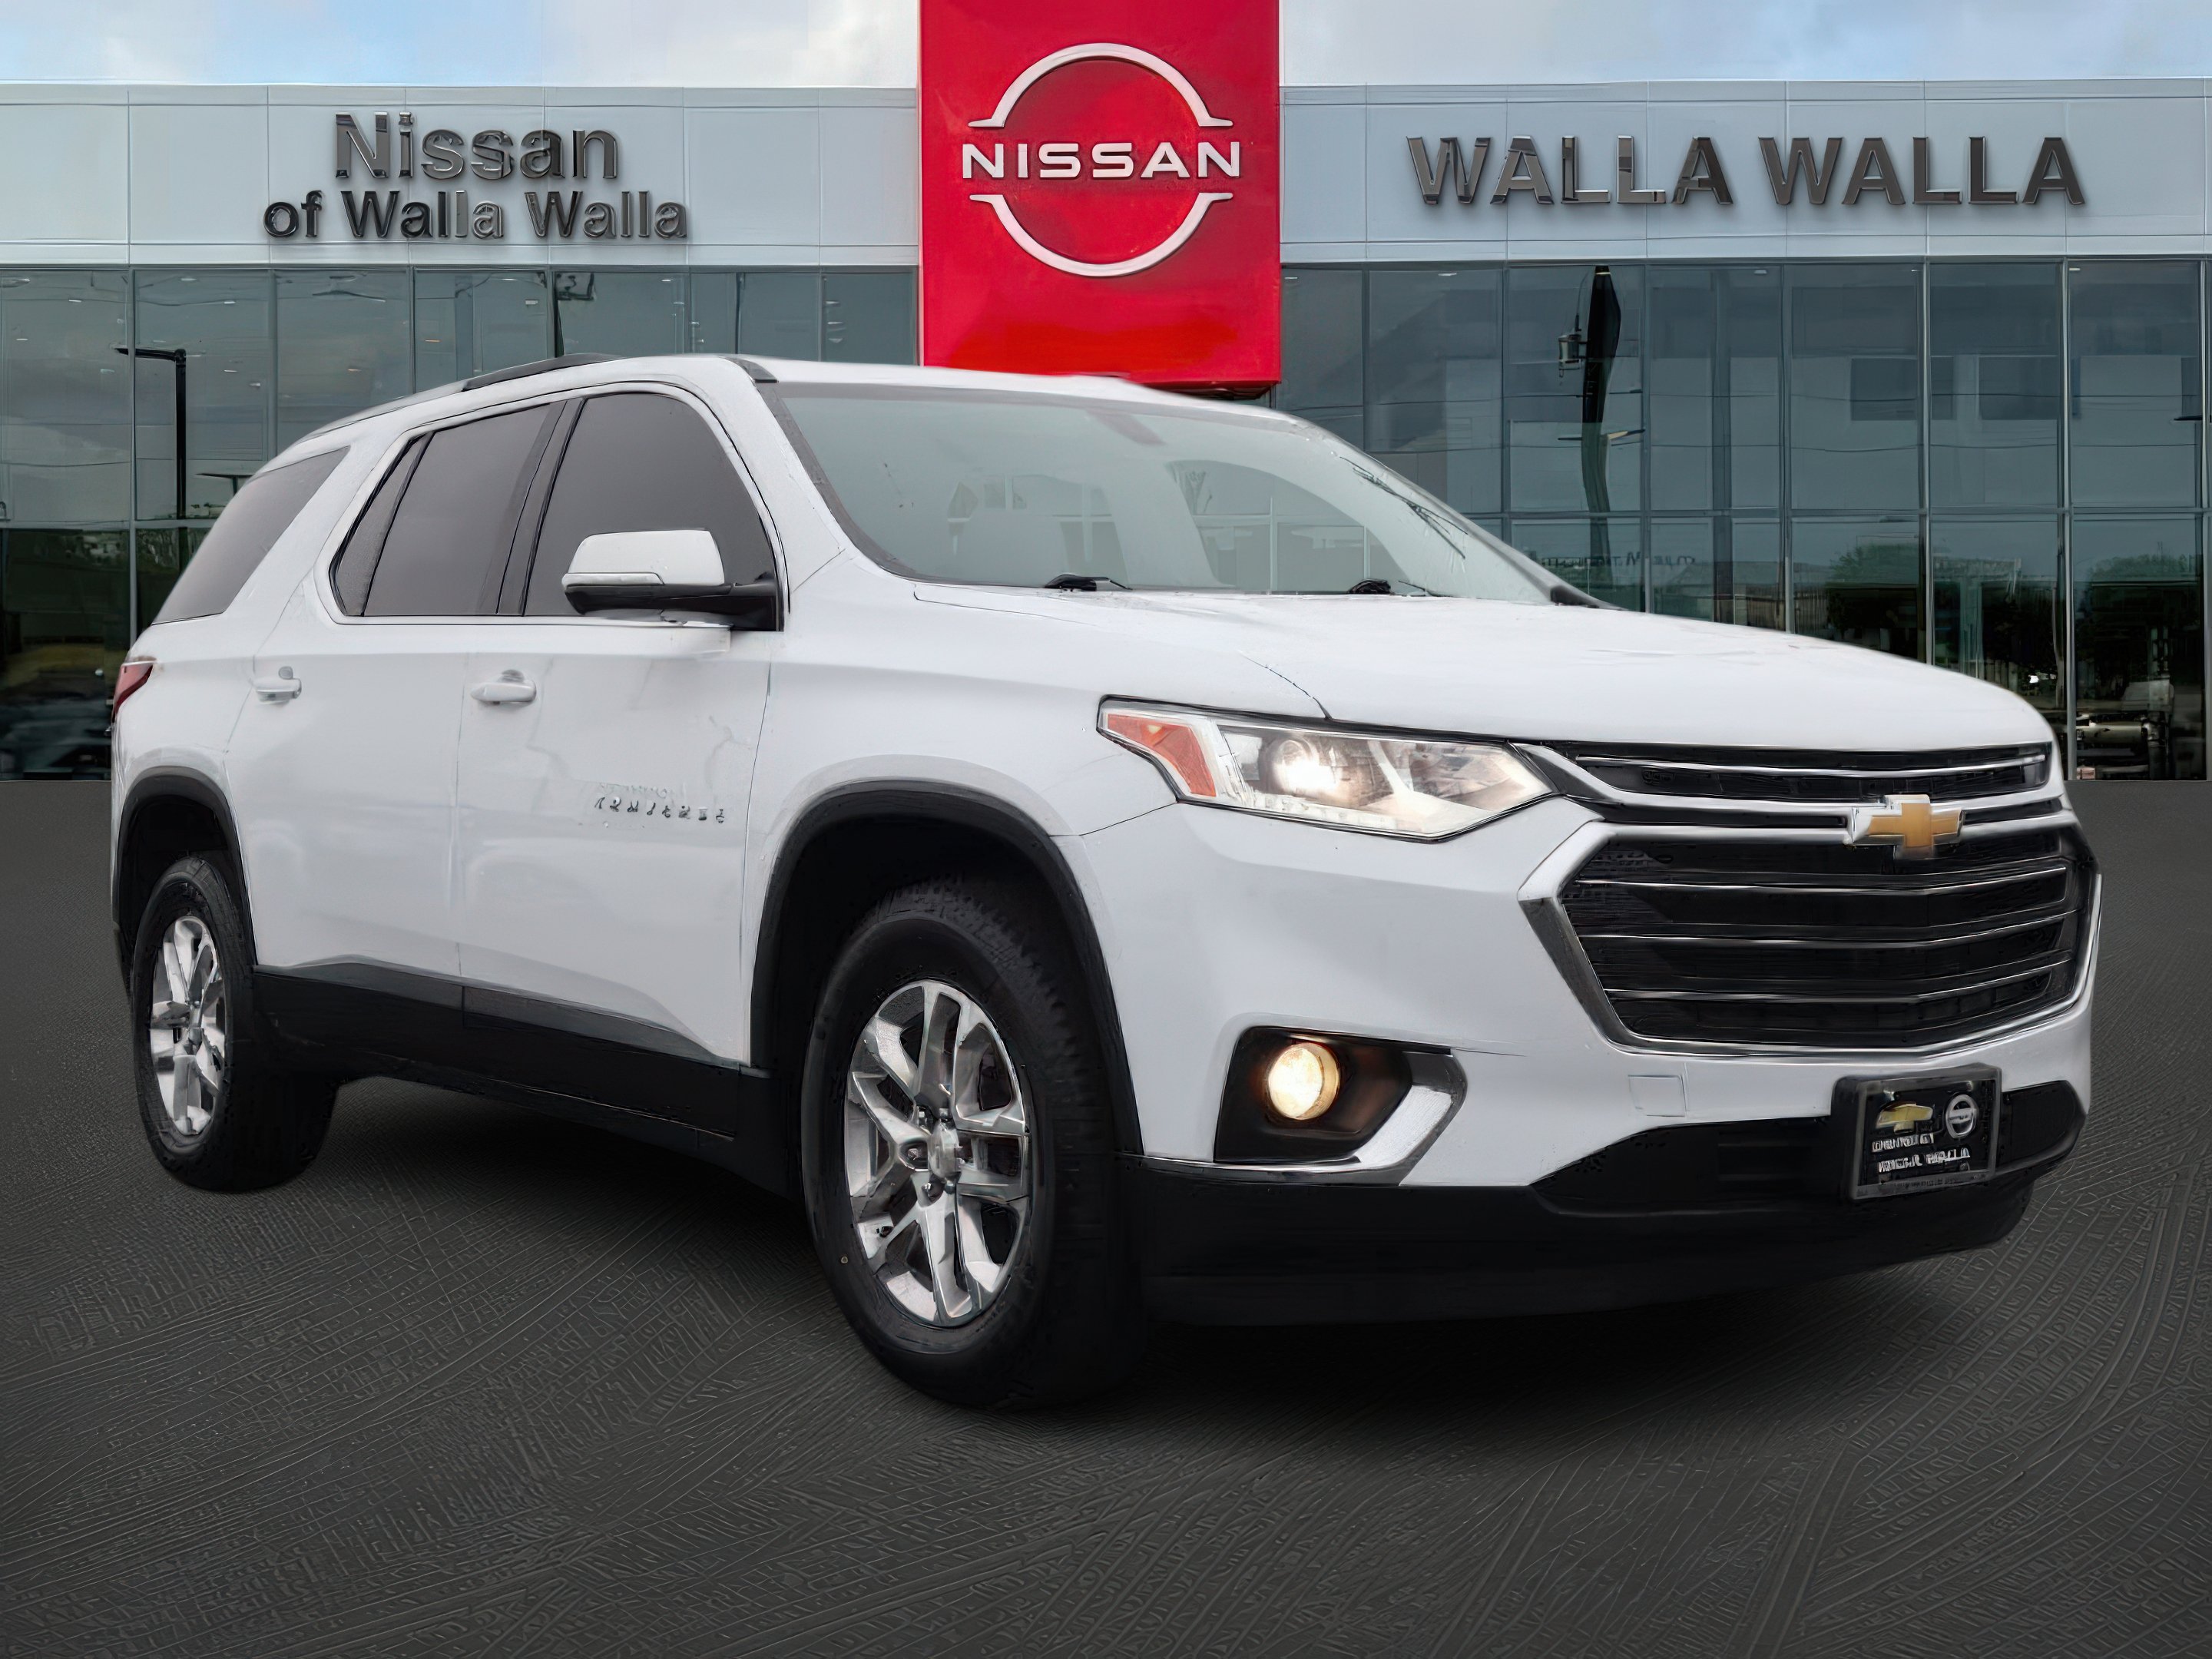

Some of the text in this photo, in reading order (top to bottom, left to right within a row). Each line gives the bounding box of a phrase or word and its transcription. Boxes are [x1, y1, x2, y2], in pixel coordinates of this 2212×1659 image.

[335, 111, 619, 180] Nissan
[962, 141, 1240, 179] NISSAN
[1406, 134, 2086, 206] WALLA WALLA
[263, 190, 687, 238] of Walla Walla
